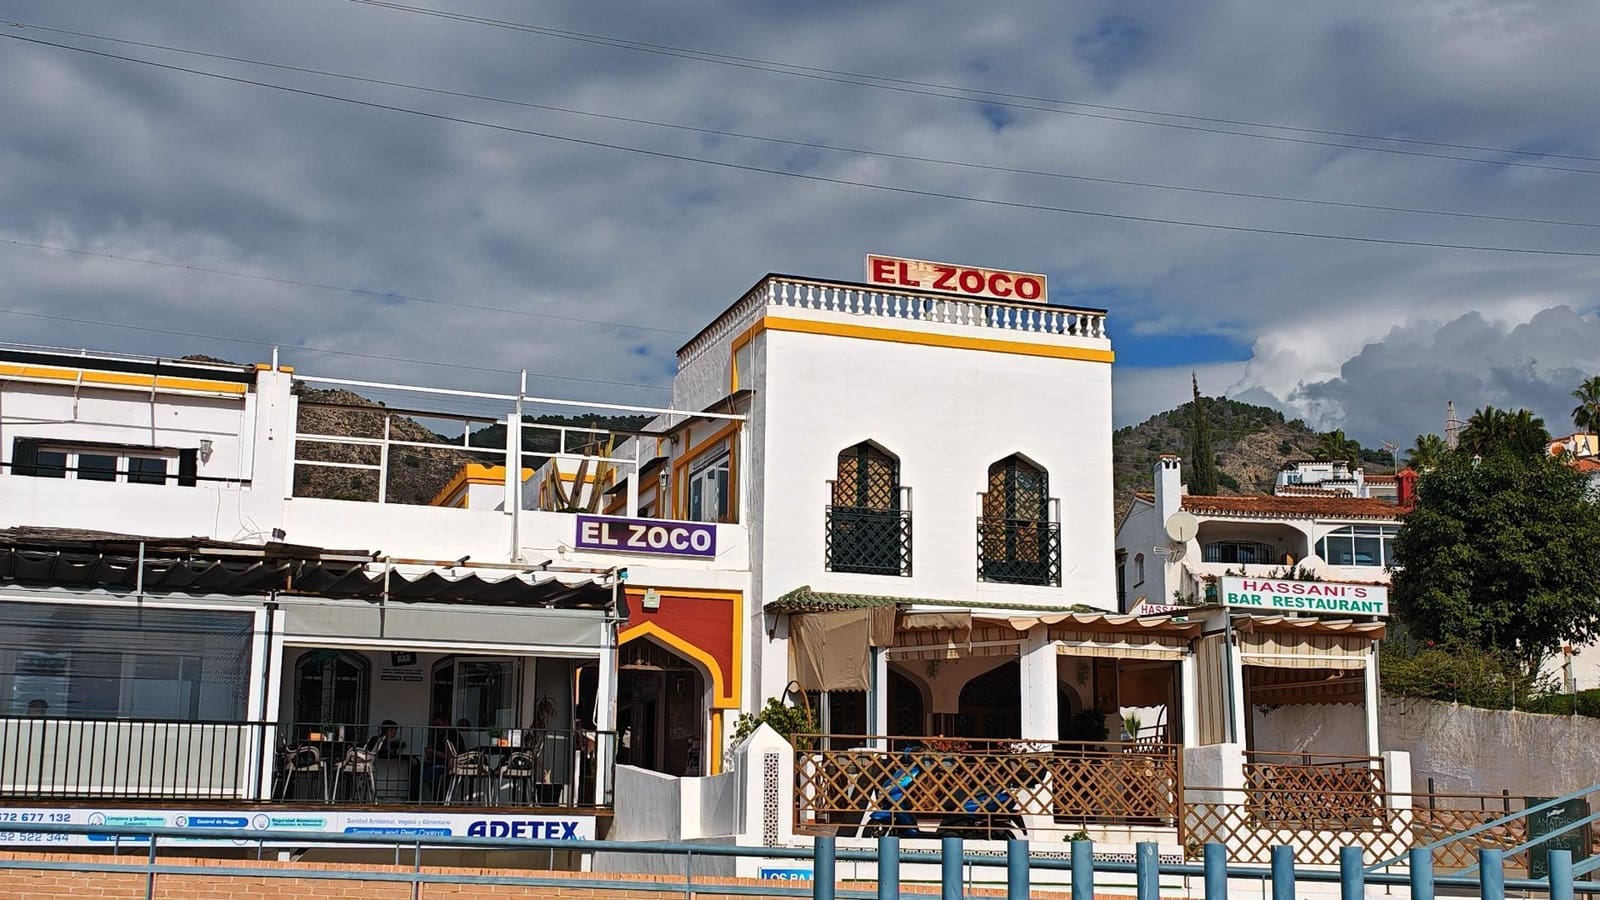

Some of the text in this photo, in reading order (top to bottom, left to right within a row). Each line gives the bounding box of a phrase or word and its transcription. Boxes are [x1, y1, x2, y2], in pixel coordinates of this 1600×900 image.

[873, 259, 1041, 300] EL ZOCO
[581, 521, 711, 551] EL ZOCO
[1227, 593, 1383, 613] BAR RESTAURANT
[21, 813, 44, 822] 677
[49, 813, 71, 822] 132
[20, 832, 41, 841] 522
[47, 833, 69, 841] 344
[467, 820, 579, 840] ADETEX
